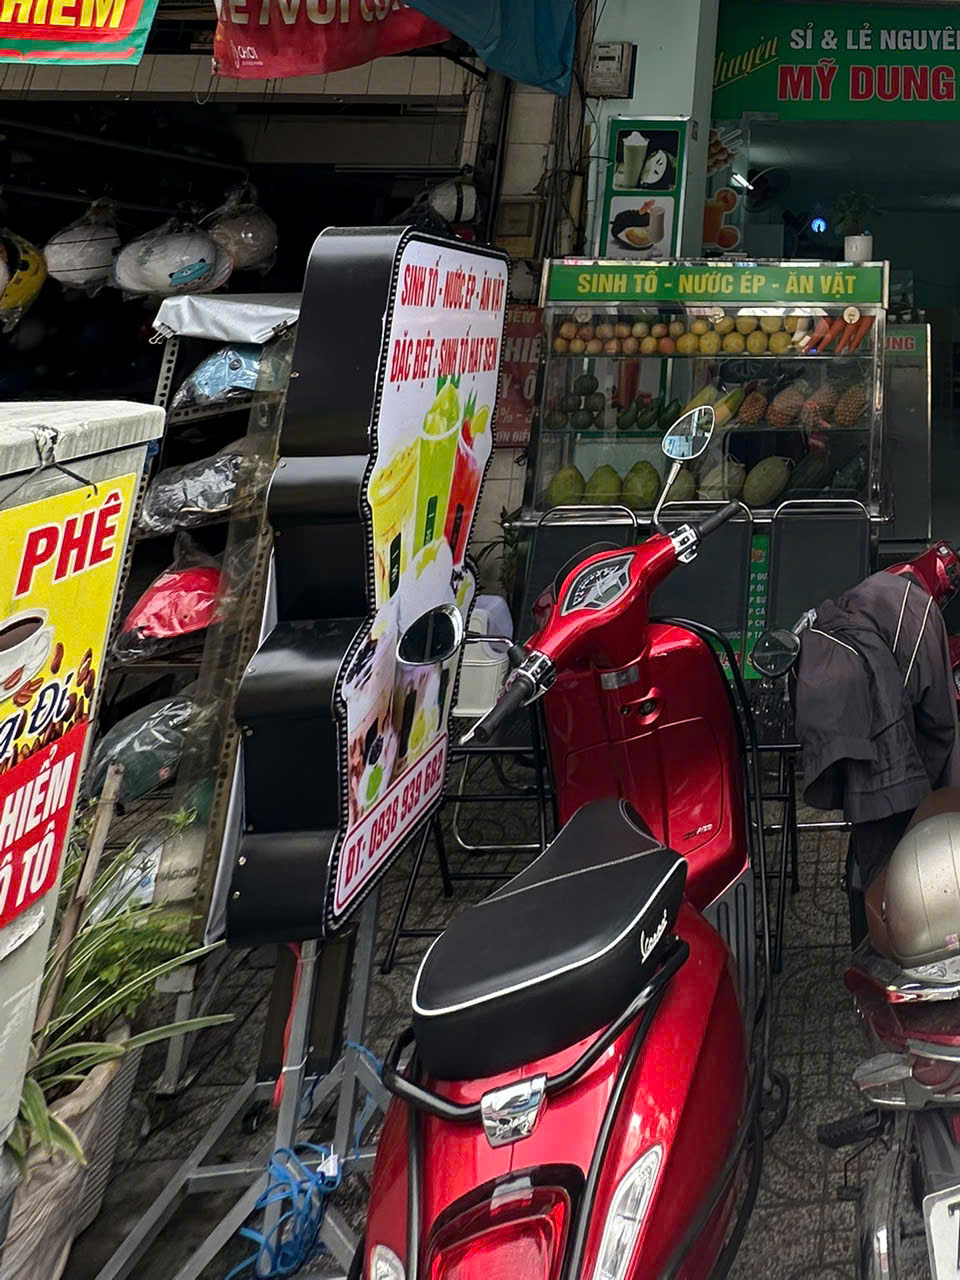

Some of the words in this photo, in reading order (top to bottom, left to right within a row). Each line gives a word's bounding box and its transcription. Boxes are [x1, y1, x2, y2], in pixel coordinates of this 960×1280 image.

[790, 22, 814, 50] SỈ
[821, 29, 838, 50] &
[846, 22, 872, 50] LẺ
[777, 57, 839, 101] MỸ
[849, 65, 955, 102] DUNG
[400, 263, 427, 306] SINH
[425, 254, 442, 308] TỐ
[577, 273, 627, 294] SINH
[633, 268, 659, 293] TỐ
[679, 271, 733, 294] NƯỚC
[740, 271, 766, 294] ÉP
[785, 273, 813, 294] ĂN
[820, 274, 857, 298] VẶT
[389, 329, 413, 393] ĐẶC
[412, 329, 435, 389] BIỆT
[438, 338, 460, 377] SINH
[459, 324, 472, 374] TỐ
[468, 337, 485, 381] HẠT
[482, 337, 499, 372] SEN
[15, 492, 123, 599] PHÊ
[0, 743, 76, 850] HIỂM
[368, 794, 400, 860] 0938
[400, 770, 423, 822] 939
[423, 748, 444, 797] 682
[16, 820, 56, 908] TÔ
